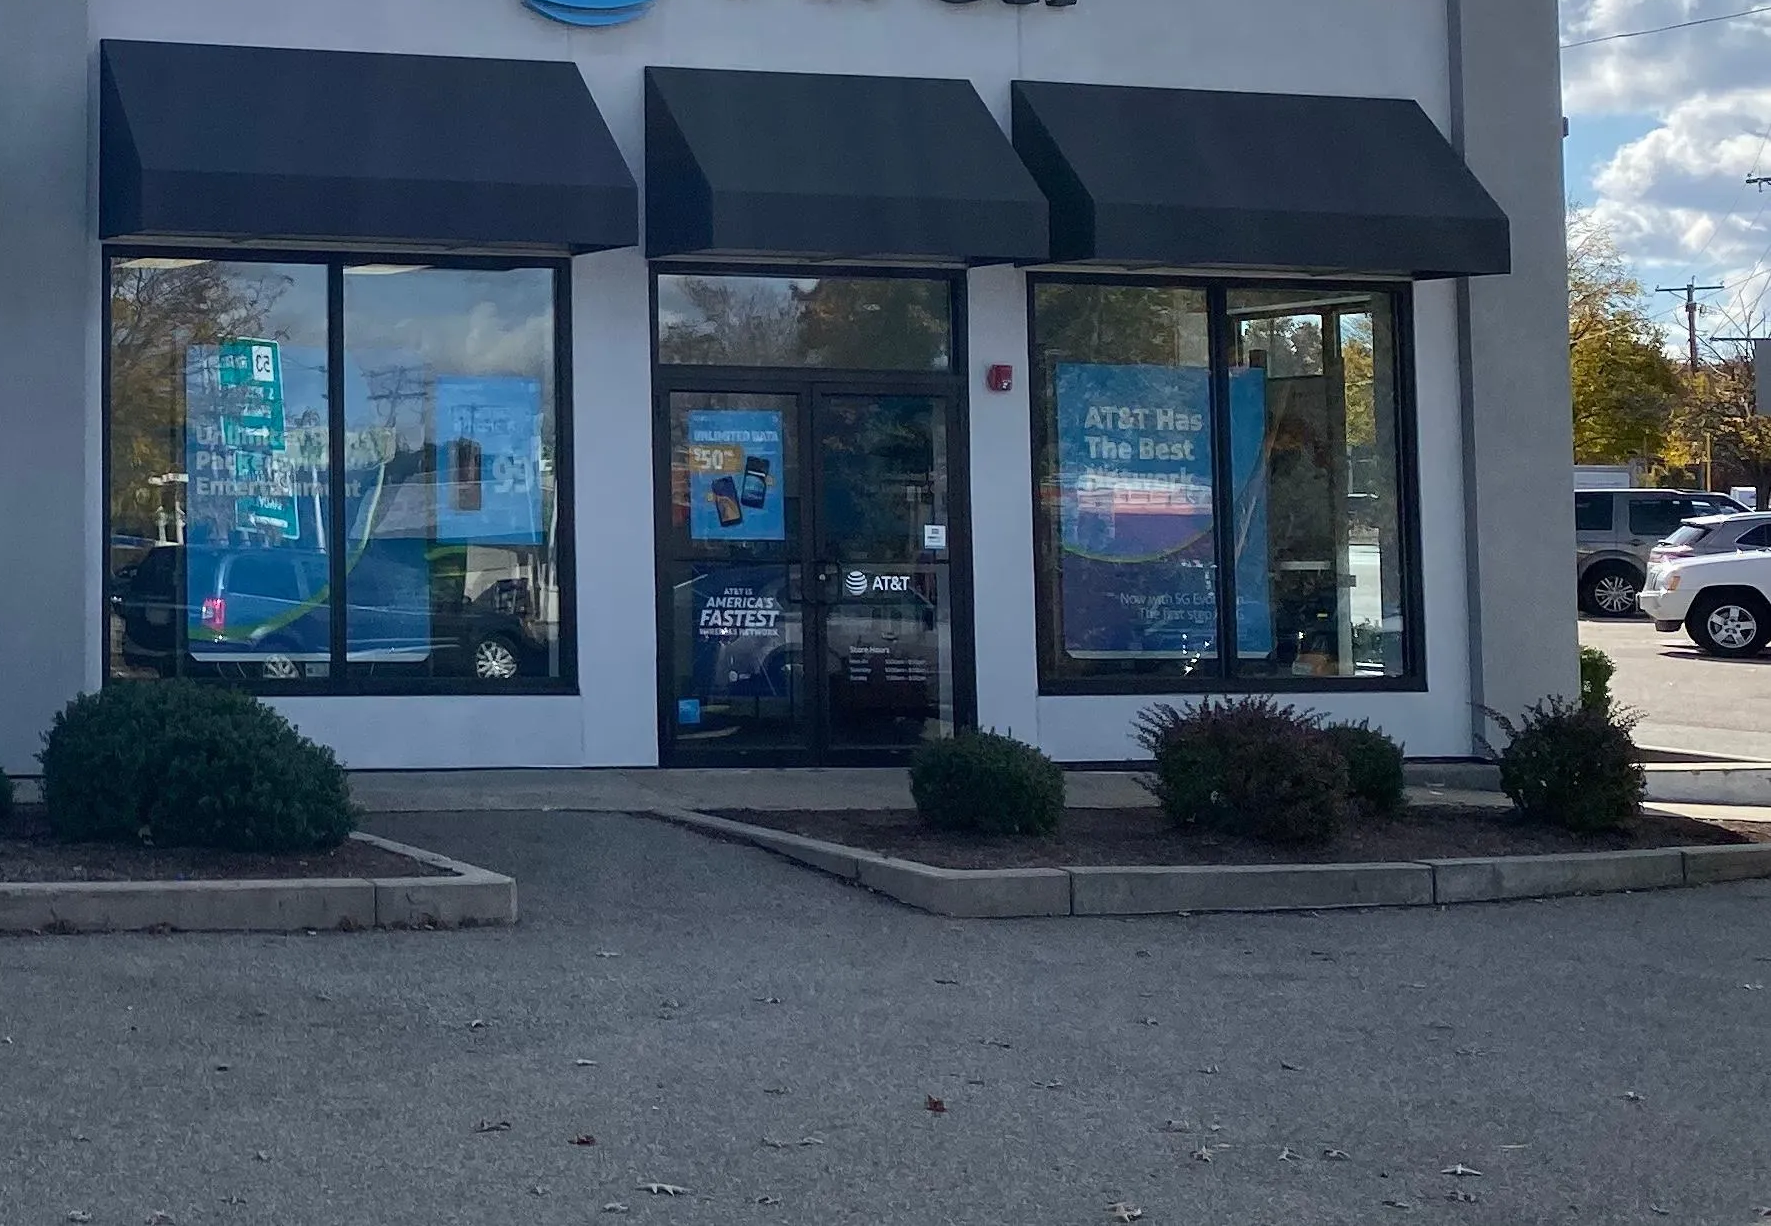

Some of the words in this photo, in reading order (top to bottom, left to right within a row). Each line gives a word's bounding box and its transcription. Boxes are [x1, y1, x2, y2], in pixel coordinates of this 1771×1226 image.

[1085, 406, 1149, 431] AT&T
[1156, 408, 1203, 432] Has
[1085, 435, 1133, 460] The
[1139, 437, 1196, 461] Best
[196, 476, 362, 498] Entertainmnt
[872, 576, 910, 591] AT&T
[706, 596, 775, 608] AMERICA'S
[700, 609, 780, 627] FASTEST
